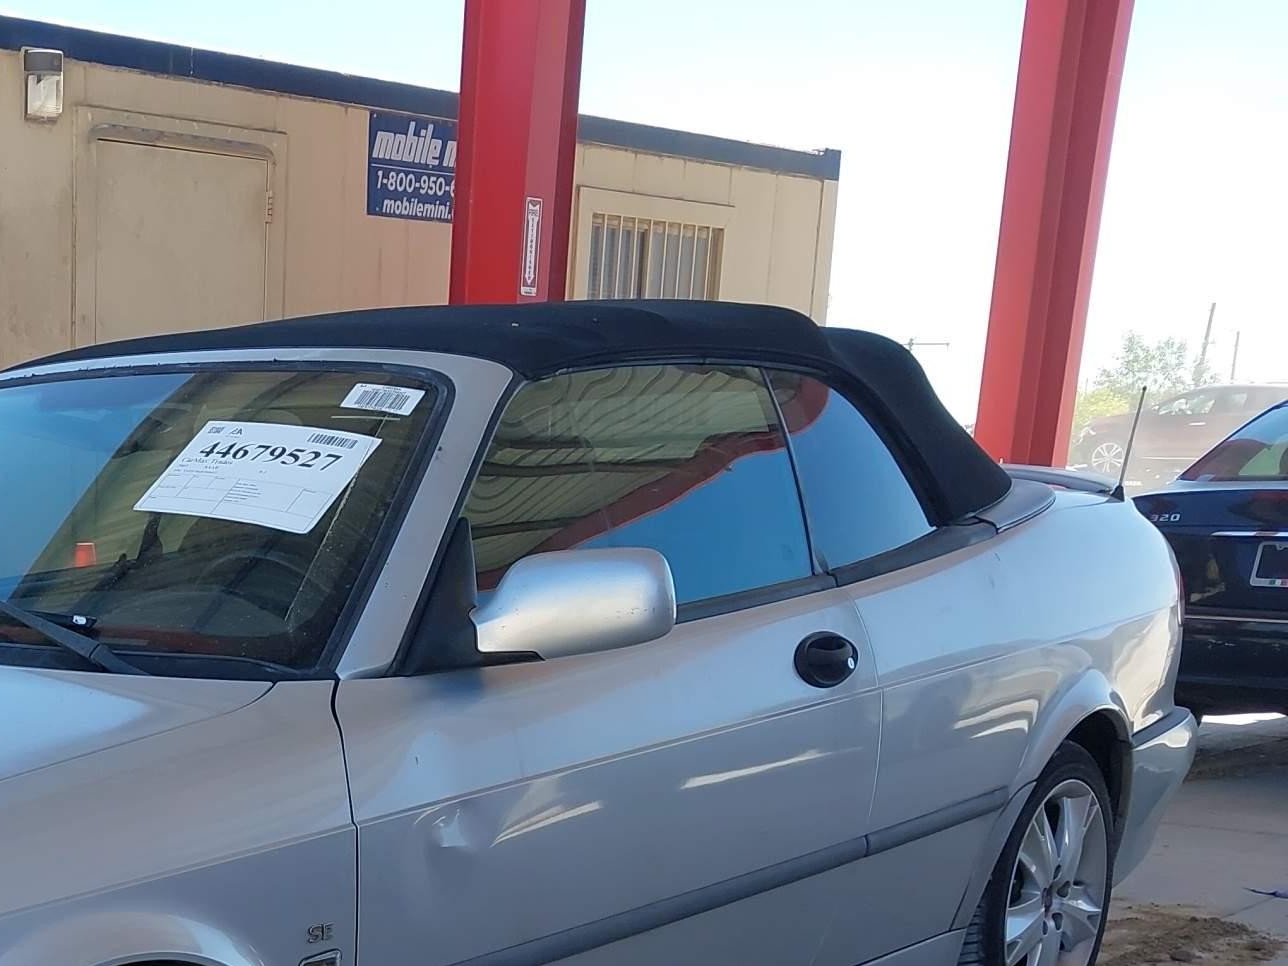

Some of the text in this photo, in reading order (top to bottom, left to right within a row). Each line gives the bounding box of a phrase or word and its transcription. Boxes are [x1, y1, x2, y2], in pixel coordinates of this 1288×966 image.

[372, 121, 443, 167] mobile
[382, 197, 453, 220] mobilemini.
[199, 441, 343, 472] 44679527
[307, 922, 335, 943] SE
